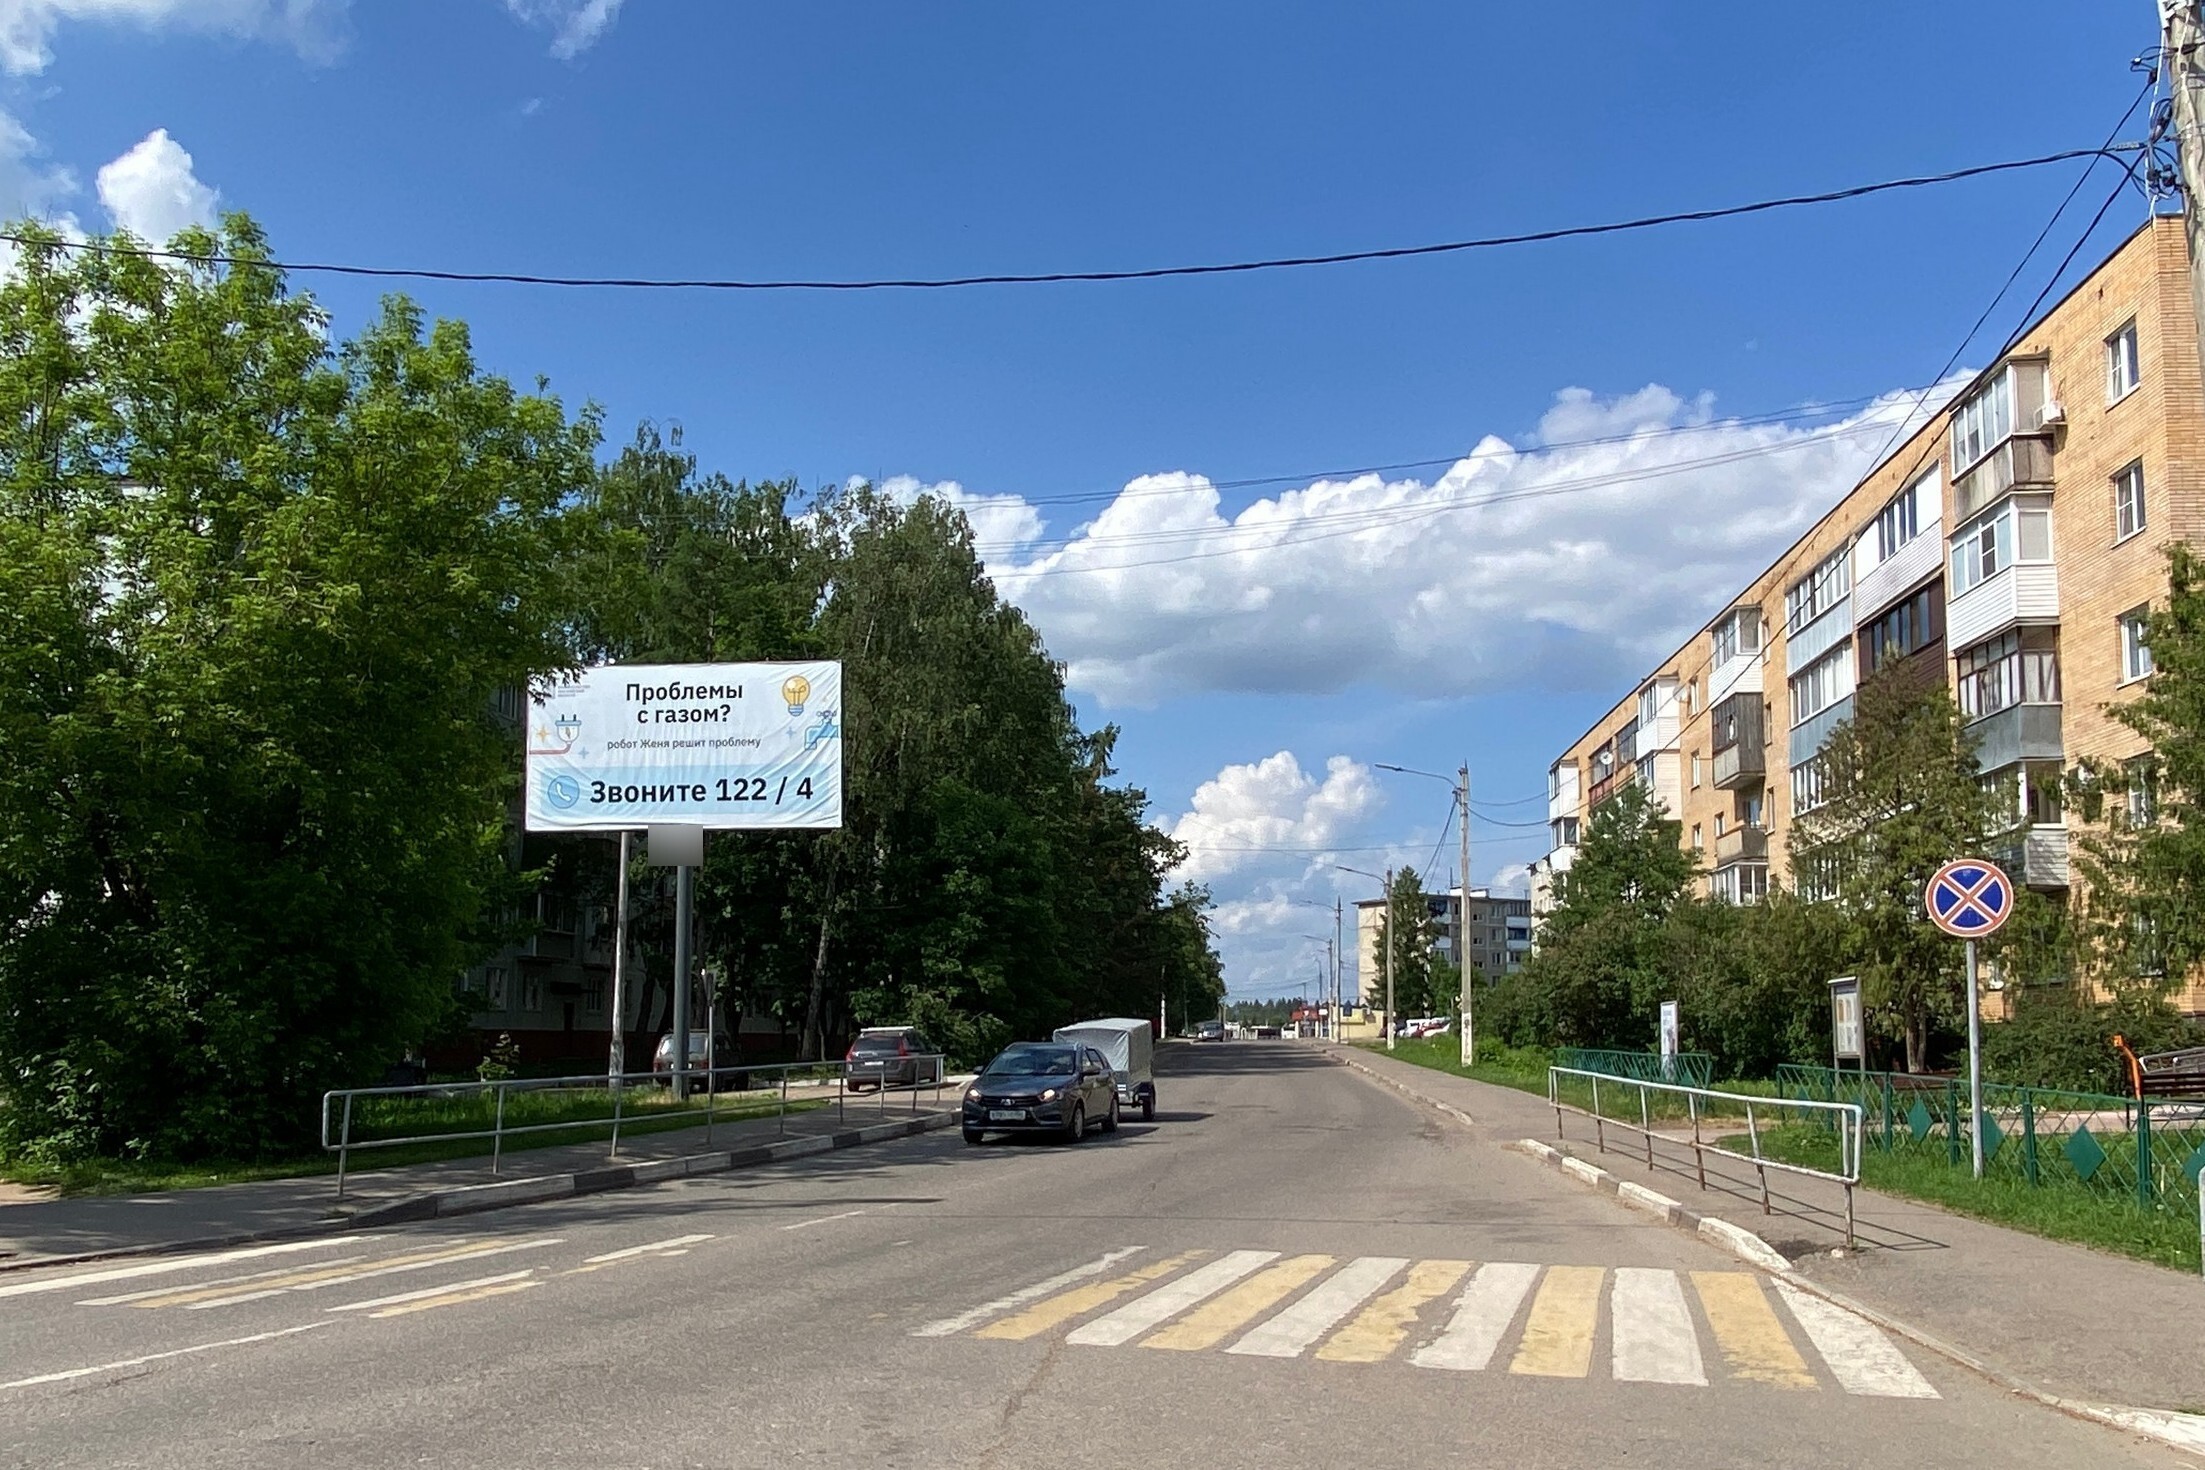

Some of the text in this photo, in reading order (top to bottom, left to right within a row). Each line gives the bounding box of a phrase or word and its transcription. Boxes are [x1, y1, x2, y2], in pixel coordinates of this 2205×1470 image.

[626, 682, 743, 704] Проблемы
[637, 704, 731, 724] с газом?
[607, 737, 762, 751] робот Женя решит проблему
[589, 776, 814, 806] Звоните 122 / 4
